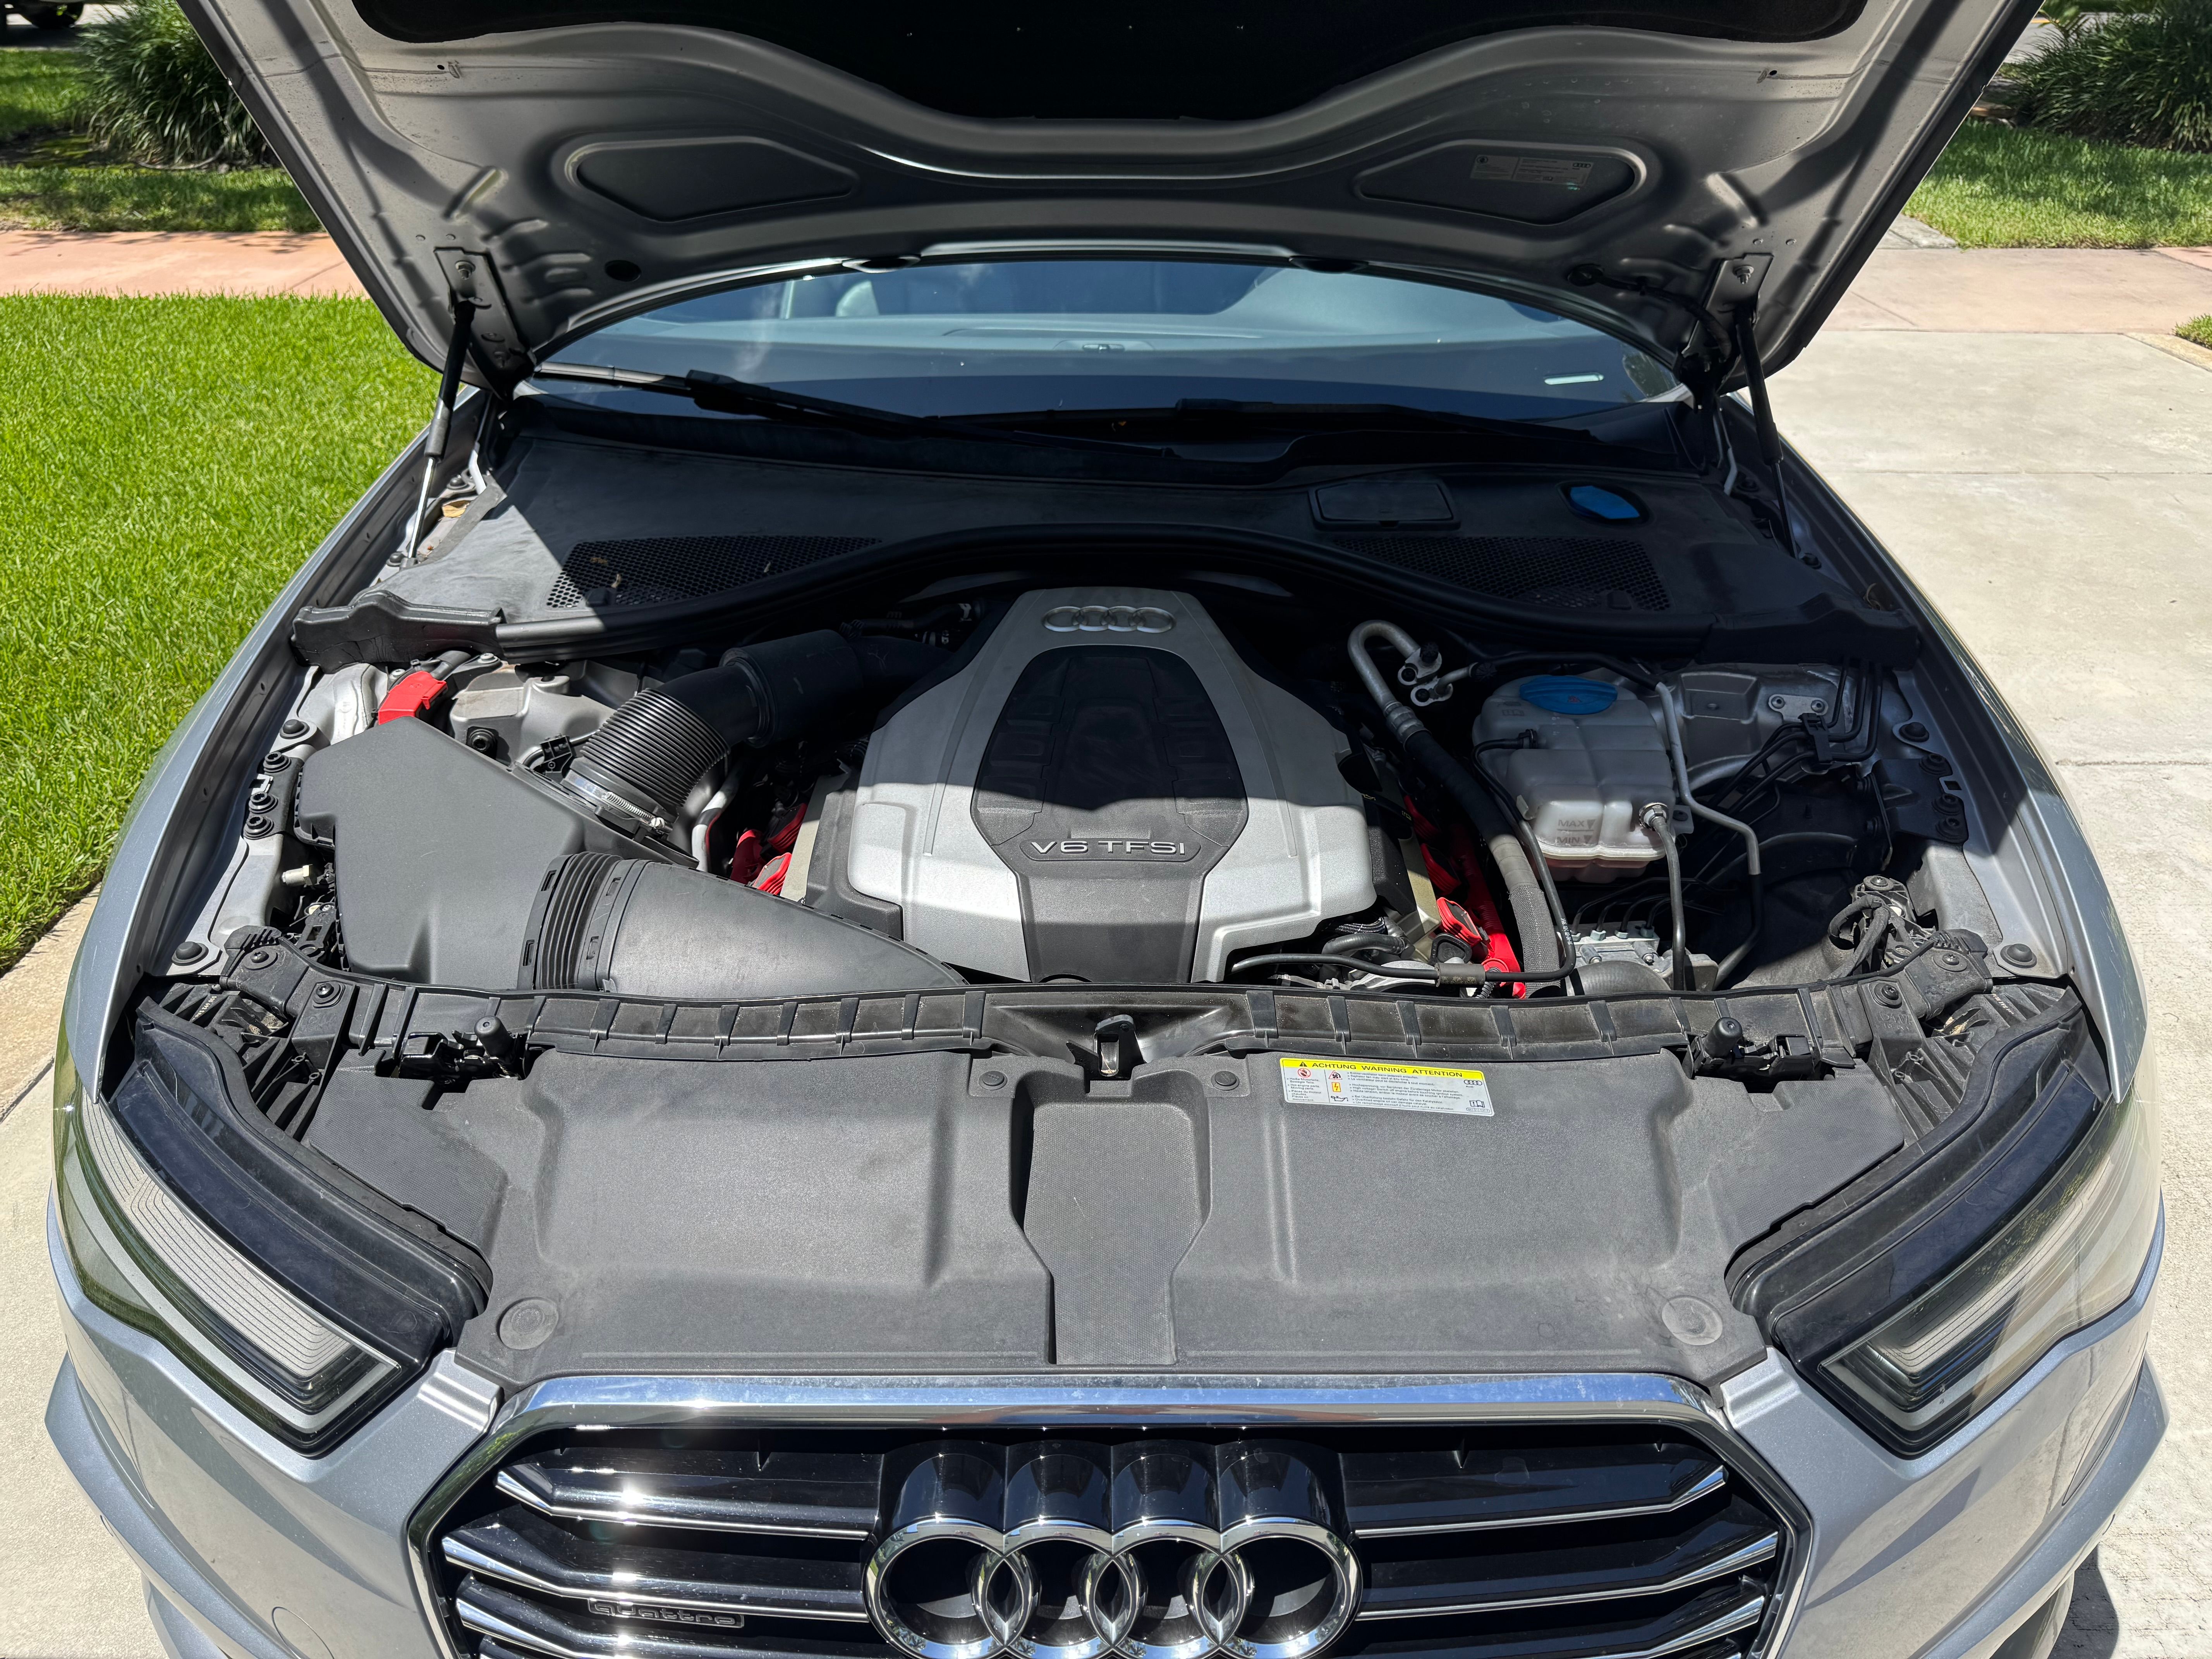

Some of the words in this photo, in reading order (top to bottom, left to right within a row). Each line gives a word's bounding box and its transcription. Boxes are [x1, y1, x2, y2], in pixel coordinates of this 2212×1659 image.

[1031, 841, 1088, 854] V6
[1098, 841, 1185, 855] TFSI
[1361, 1065, 1407, 1073] WARNING
[1412, 1069, 1463, 1077] ATTENTION
[594, 1603, 735, 1625] quattro
